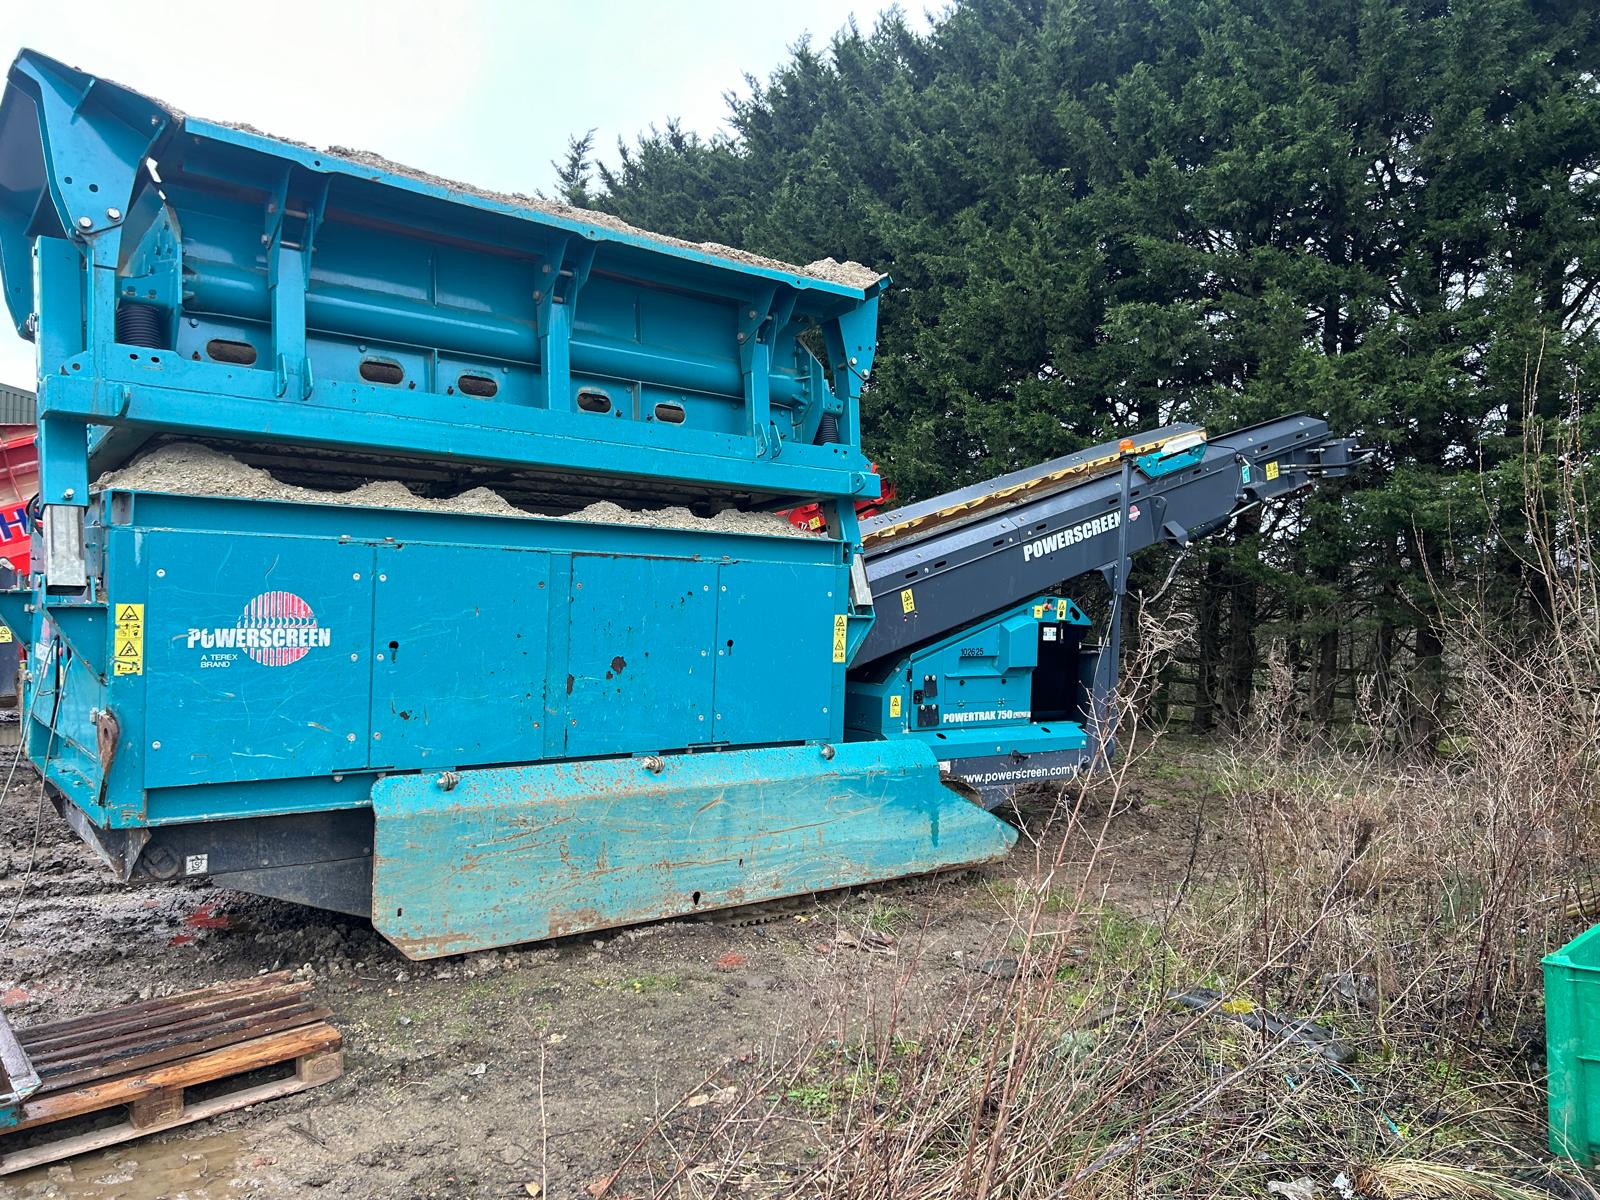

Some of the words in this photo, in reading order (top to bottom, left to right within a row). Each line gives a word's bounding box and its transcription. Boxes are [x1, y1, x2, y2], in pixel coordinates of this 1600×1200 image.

[187, 628, 331, 648] POWERSCREEN
[961, 648, 984, 656] 102625
[943, 711, 996, 723] POWERTRAK
[997, 710, 1013, 719] 750
[961, 766, 1070, 784] ww.powerscreen.com
